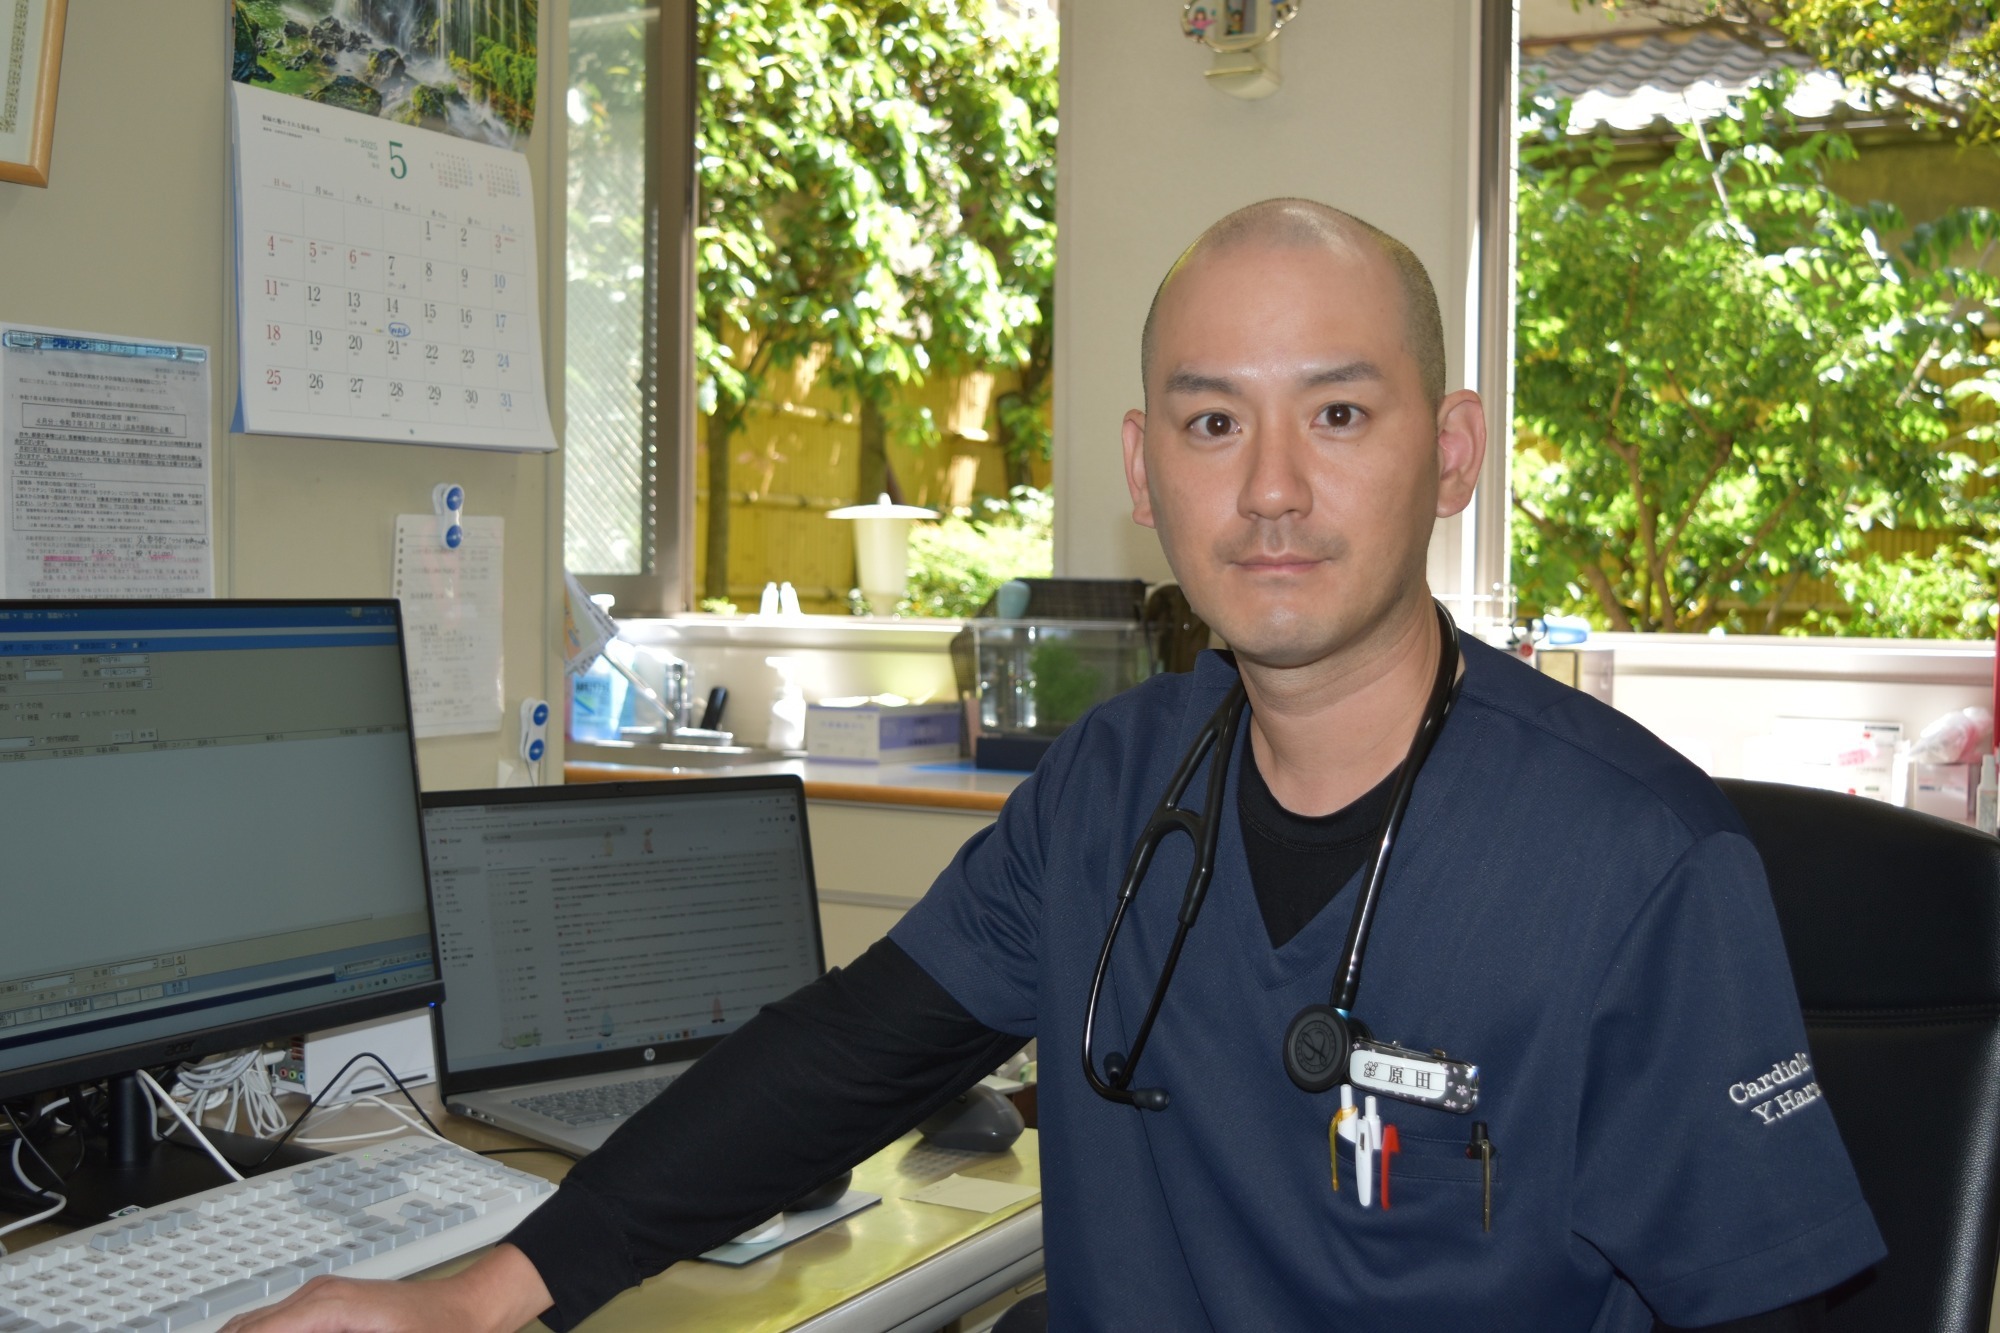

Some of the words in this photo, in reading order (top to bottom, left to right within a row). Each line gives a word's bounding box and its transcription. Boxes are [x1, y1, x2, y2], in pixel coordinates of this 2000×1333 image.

[360, 139, 378, 151] 2025
[389, 141, 407, 179] 5
[426, 220, 431, 235] 1
[461, 227, 467, 242] 2
[268, 235, 274, 251] 4
[495, 234, 501, 248] 3
[310, 242, 317, 257] 5
[349, 249, 356, 264] 6
[388, 256, 395, 270] 7
[426, 262, 432, 277] 8
[461, 268, 468, 283] 9
[494, 274, 506, 289] 10
[266, 279, 278, 296] 11
[308, 285, 321, 302] 12
[348, 291, 361, 308] 13
[387, 297, 399, 313] 14
[424, 303, 436, 318] 15
[460, 308, 472, 323] 16
[495, 313, 507, 328] 17
[267, 324, 281, 341] 18
[309, 329, 322, 345] 19
[349, 335, 363, 351] 20
[387, 339, 400, 355] 21
[425, 344, 439, 359] 22
[462, 349, 475, 364] 23
[497, 353, 510, 368] 24
[266, 369, 281, 386] 25
[309, 373, 324, 389] 26
[350, 378, 364, 393] 27
[390, 382, 404, 397] 28
[428, 385, 441, 401] 29
[465, 389, 478, 404] 30
[500, 393, 512, 407] 31
